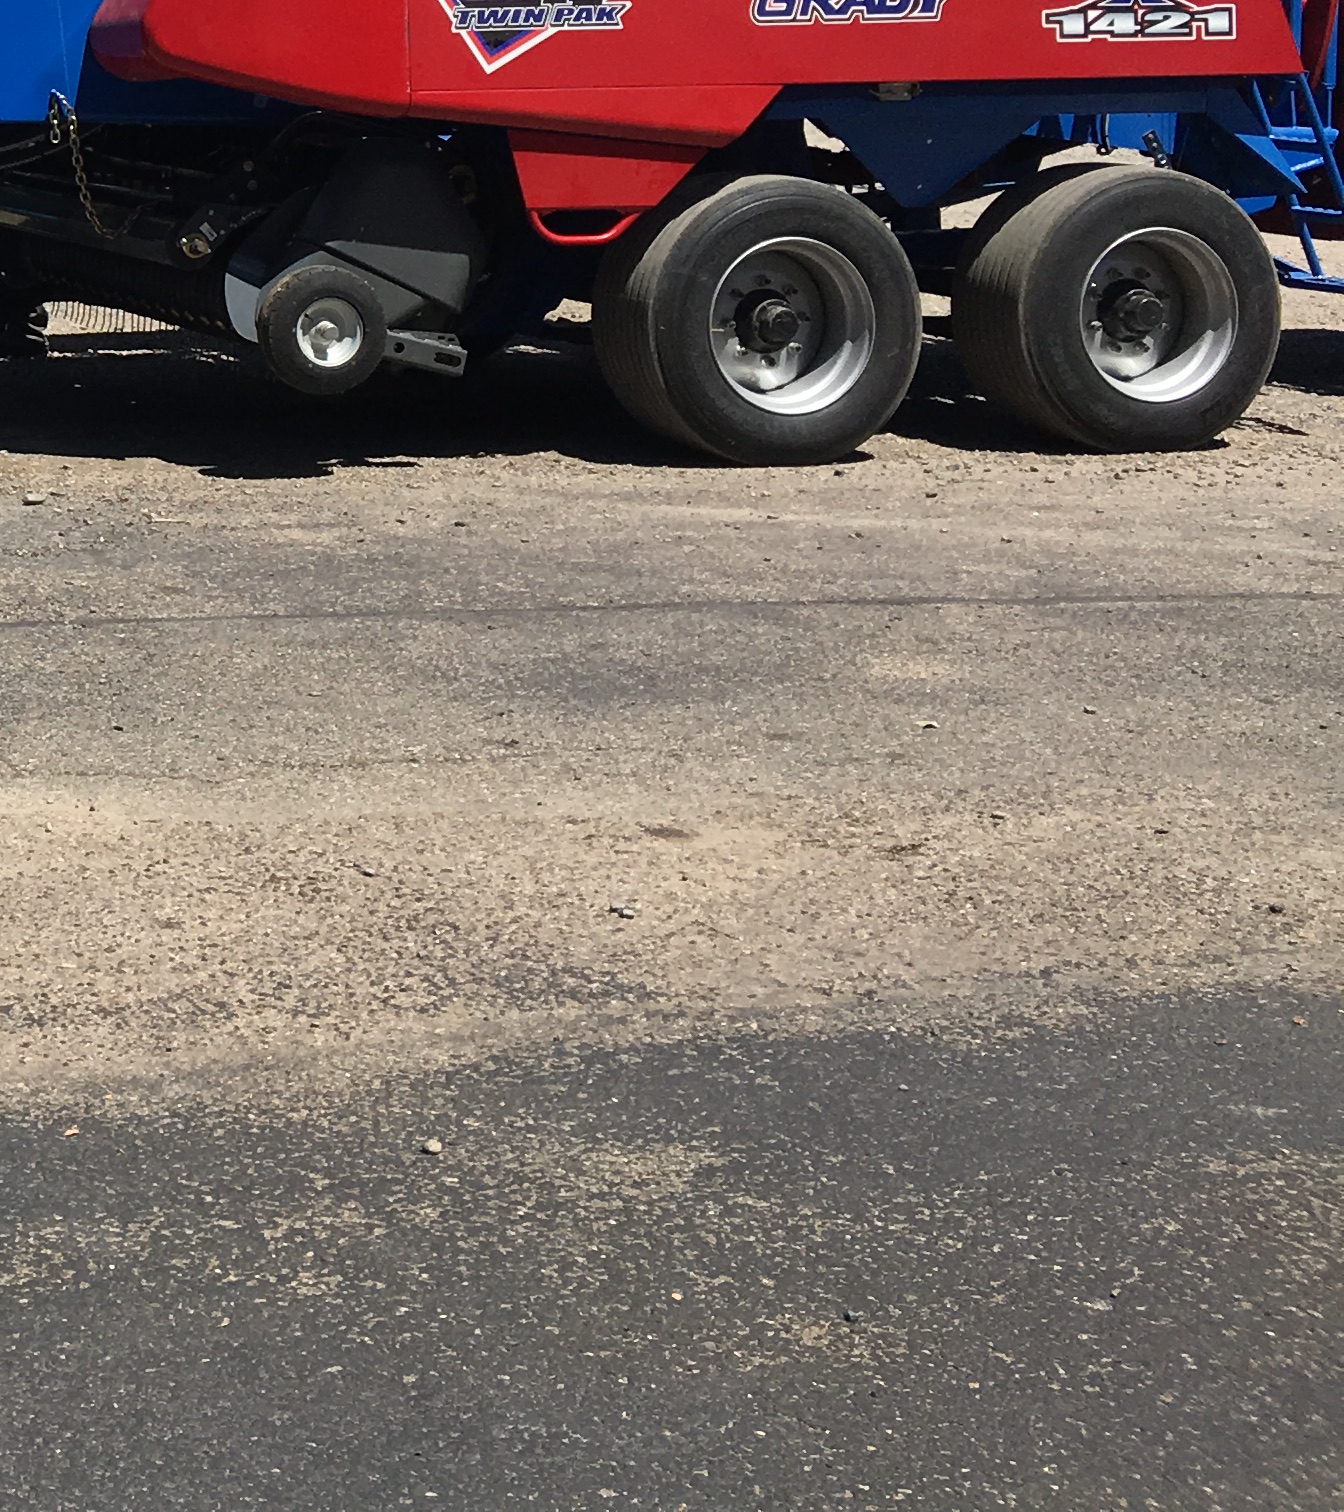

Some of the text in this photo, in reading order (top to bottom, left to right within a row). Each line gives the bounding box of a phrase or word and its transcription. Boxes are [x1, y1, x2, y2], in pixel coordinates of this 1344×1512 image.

[455, 5, 620, 26] TWIN PAK
[1049, 10, 1230, 35] 1421
